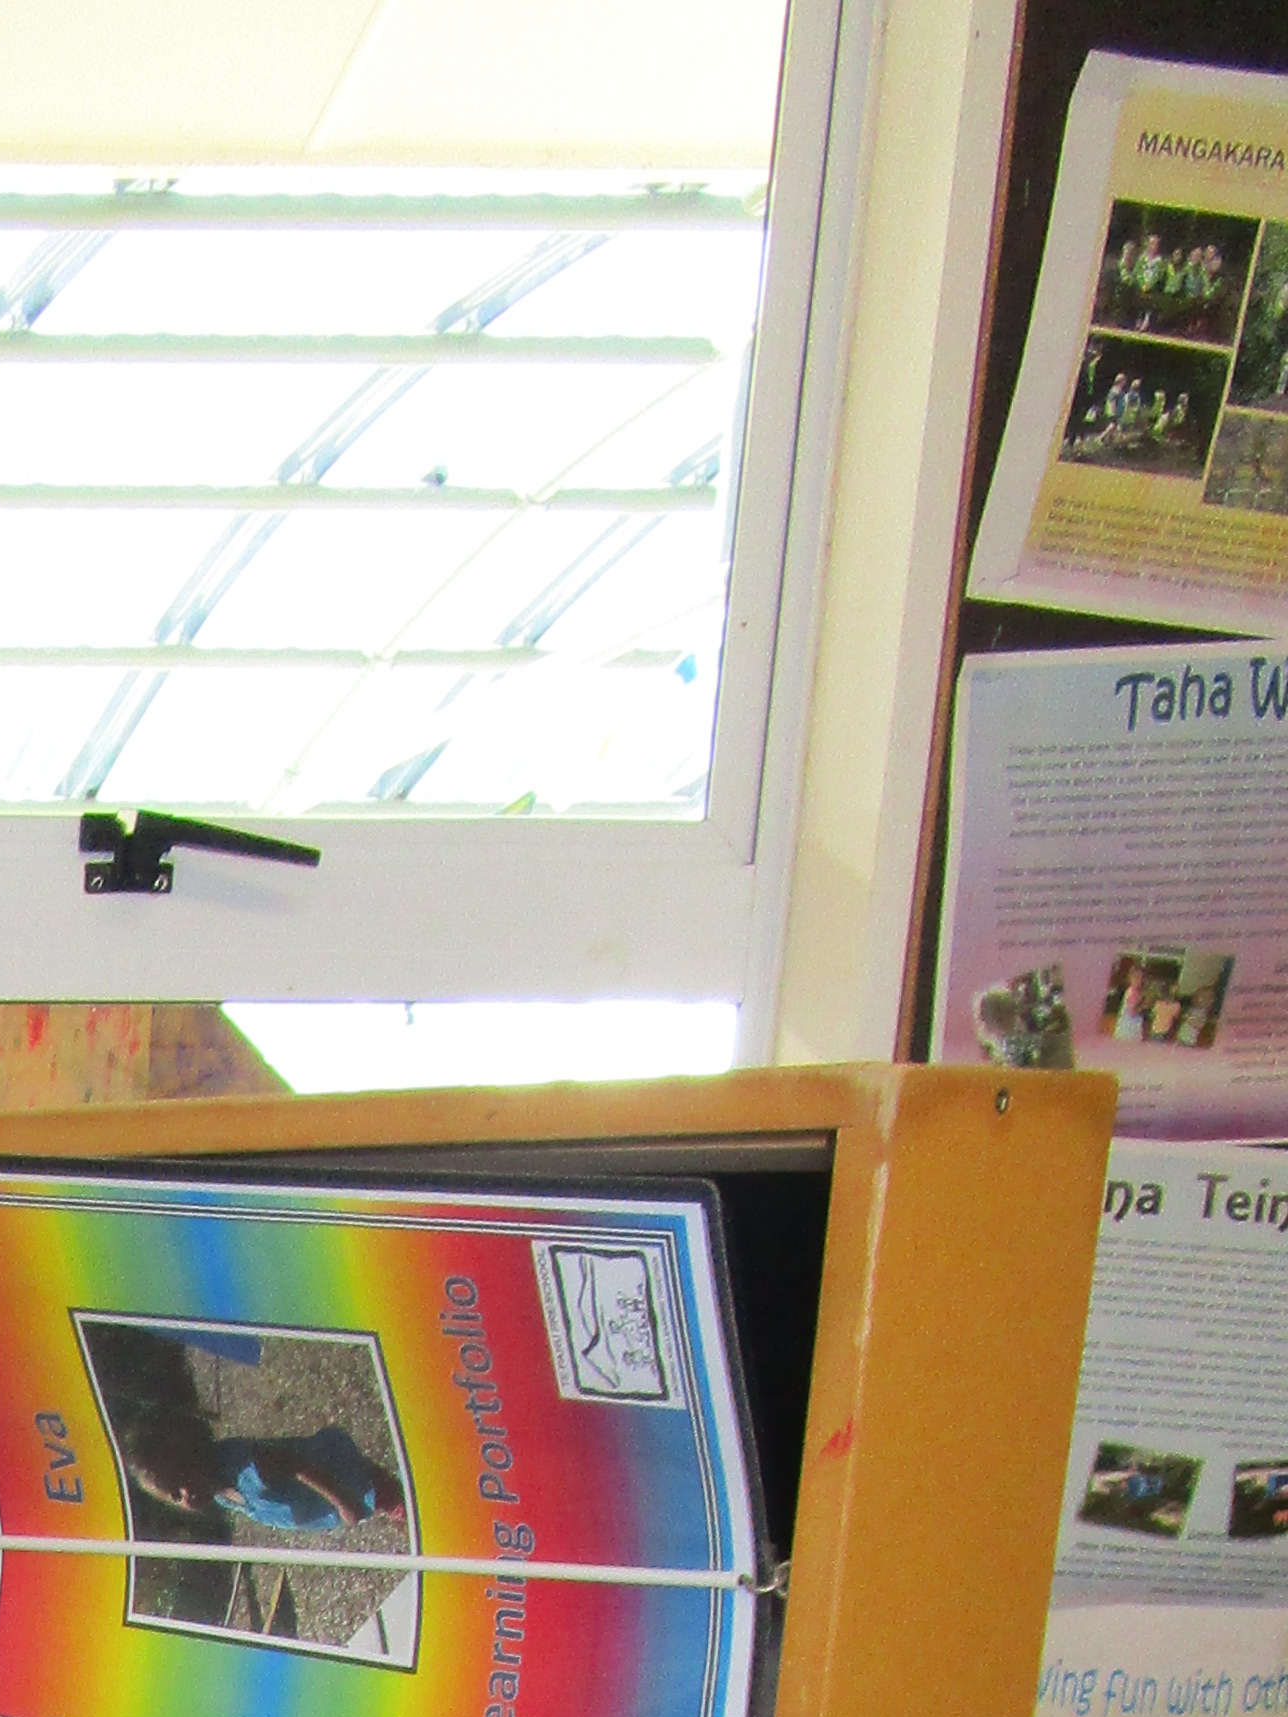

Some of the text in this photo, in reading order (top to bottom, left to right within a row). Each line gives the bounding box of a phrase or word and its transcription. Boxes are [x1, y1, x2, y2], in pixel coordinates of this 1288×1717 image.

[1136, 130, 1285, 172] MANGAKARA
[1115, 663, 1235, 731] Taha
[442, 1274, 518, 1506] Portfolio
[33, 1409, 86, 1506] Eva
[1102, 1668, 1159, 1717] fun
[1166, 1669, 1235, 1717] with
